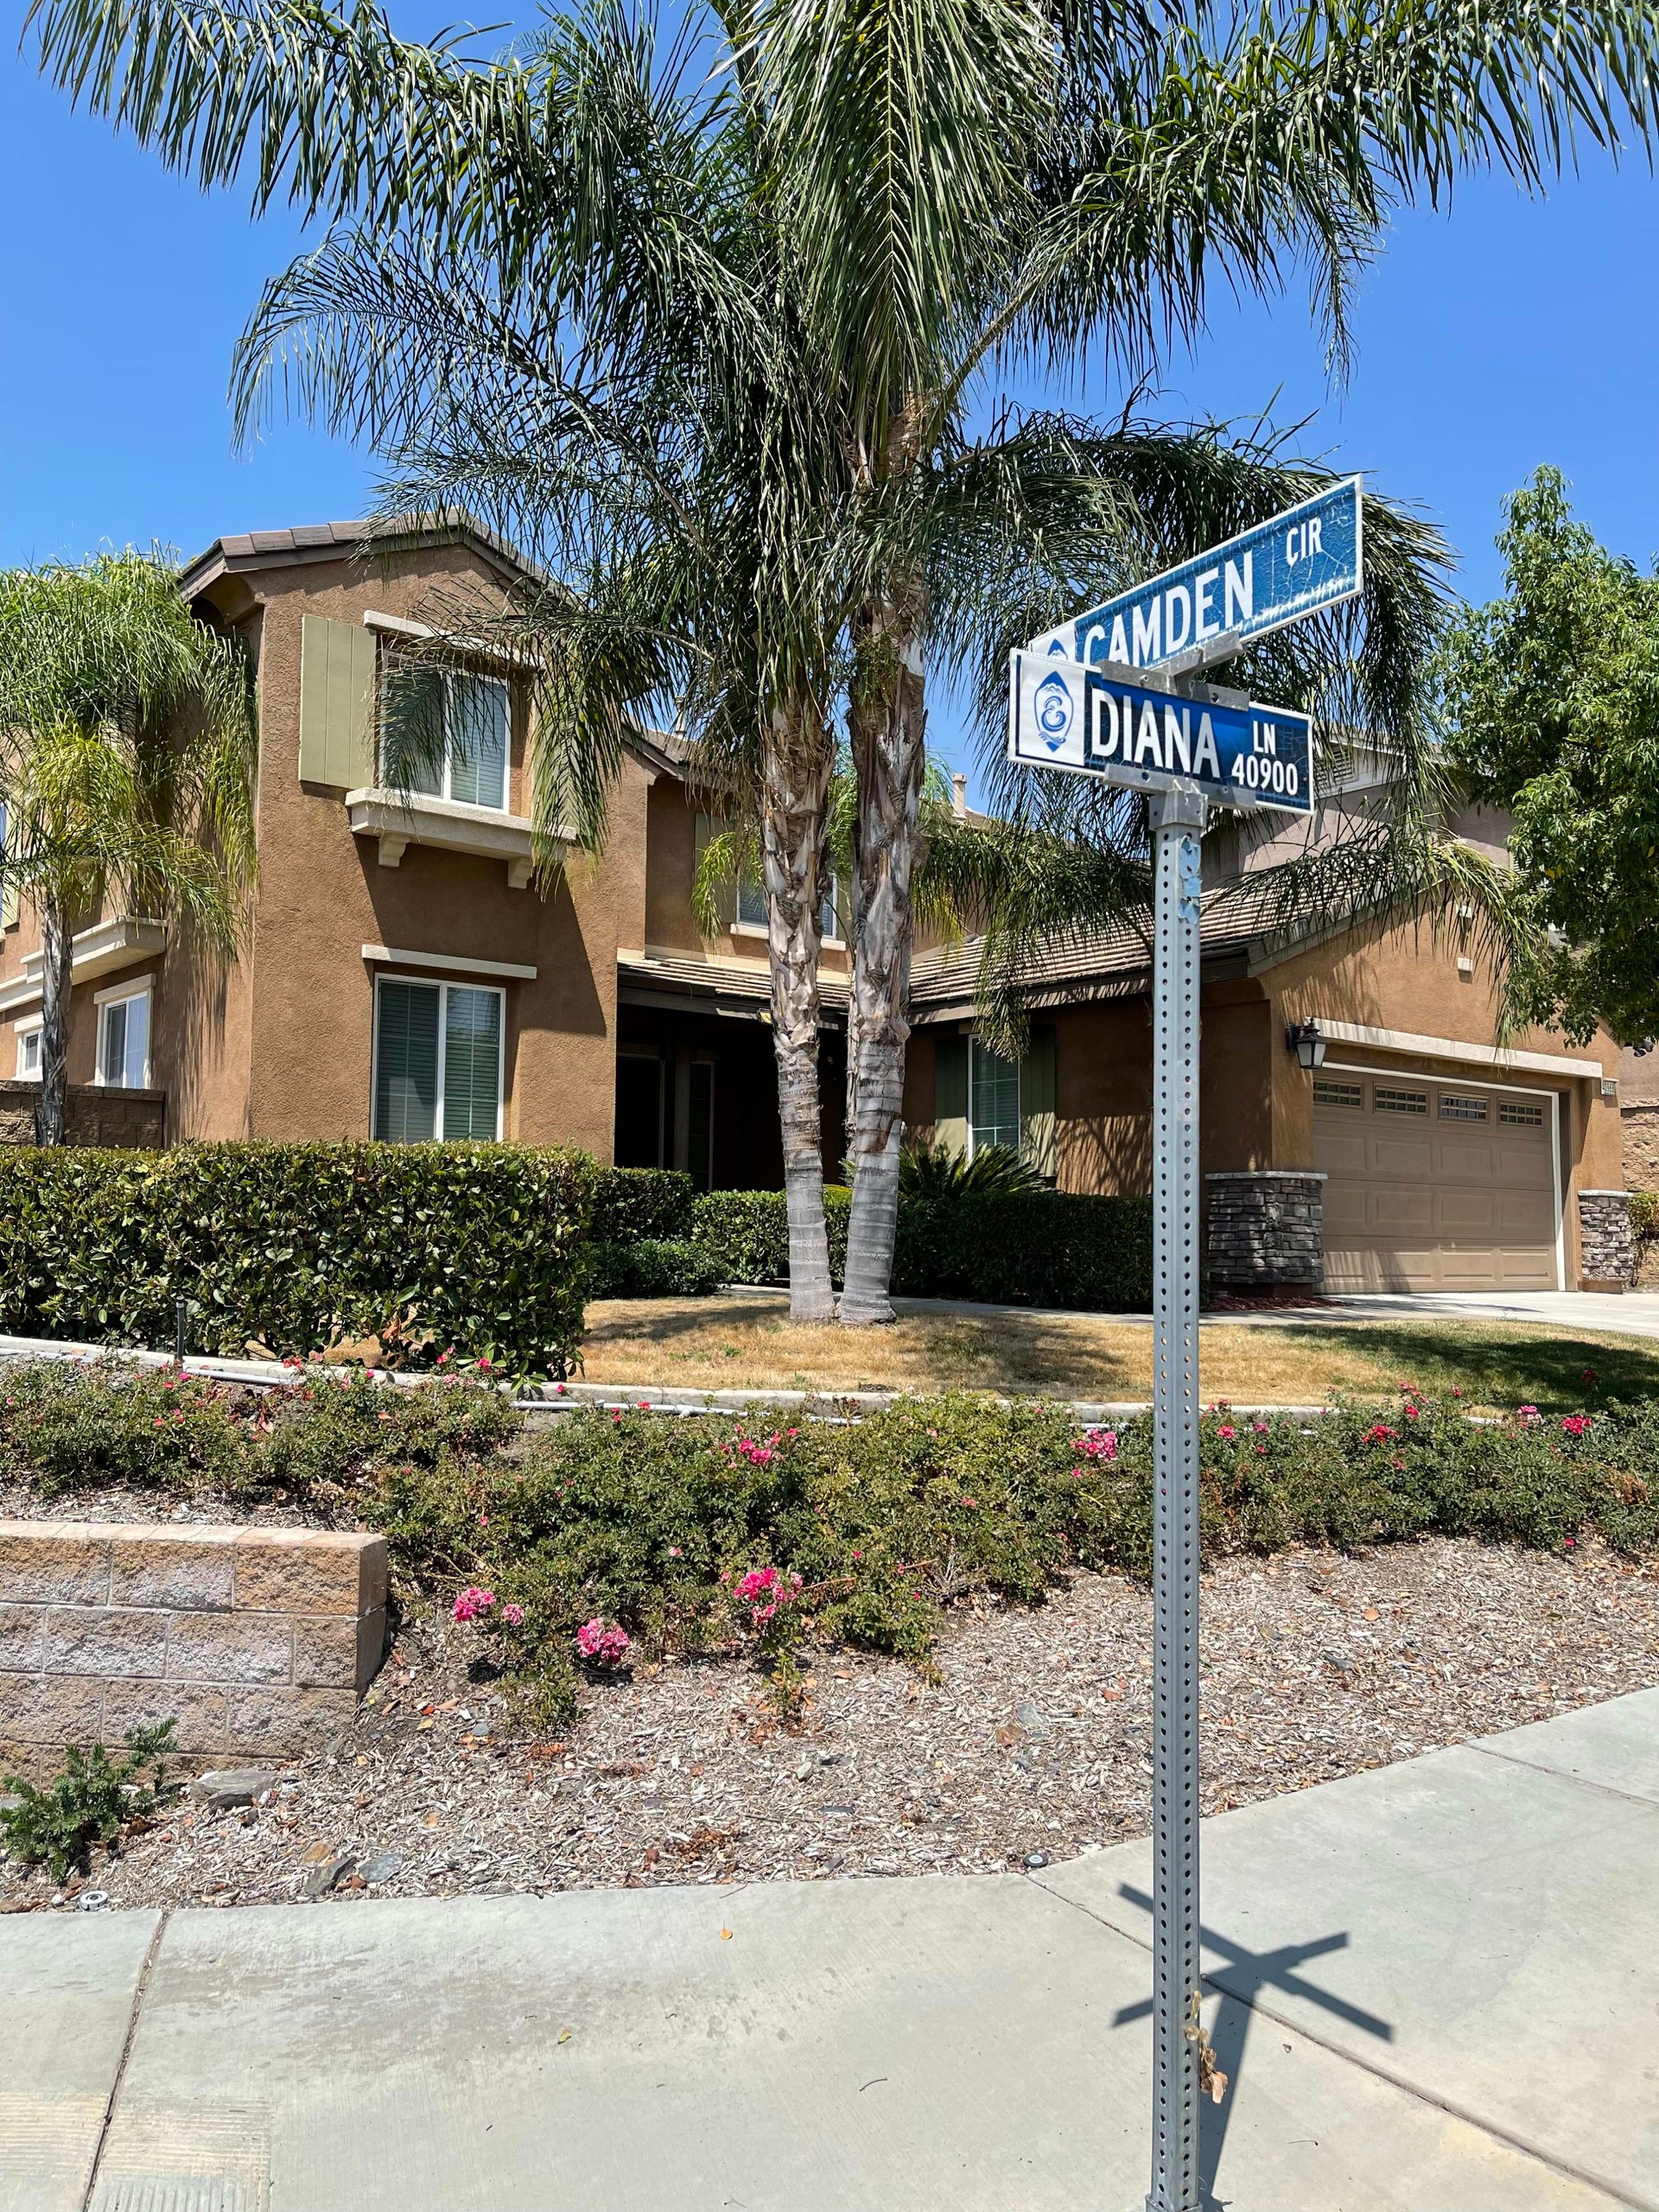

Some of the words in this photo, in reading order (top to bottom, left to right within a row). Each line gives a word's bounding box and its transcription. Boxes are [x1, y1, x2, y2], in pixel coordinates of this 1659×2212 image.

[1085, 551, 1253, 669] CAMDEN
[1286, 518, 1323, 567] CIR
[1090, 688, 1221, 779] DIANA
[1253, 721, 1276, 754] LN
[1231, 753, 1299, 796] 40900
